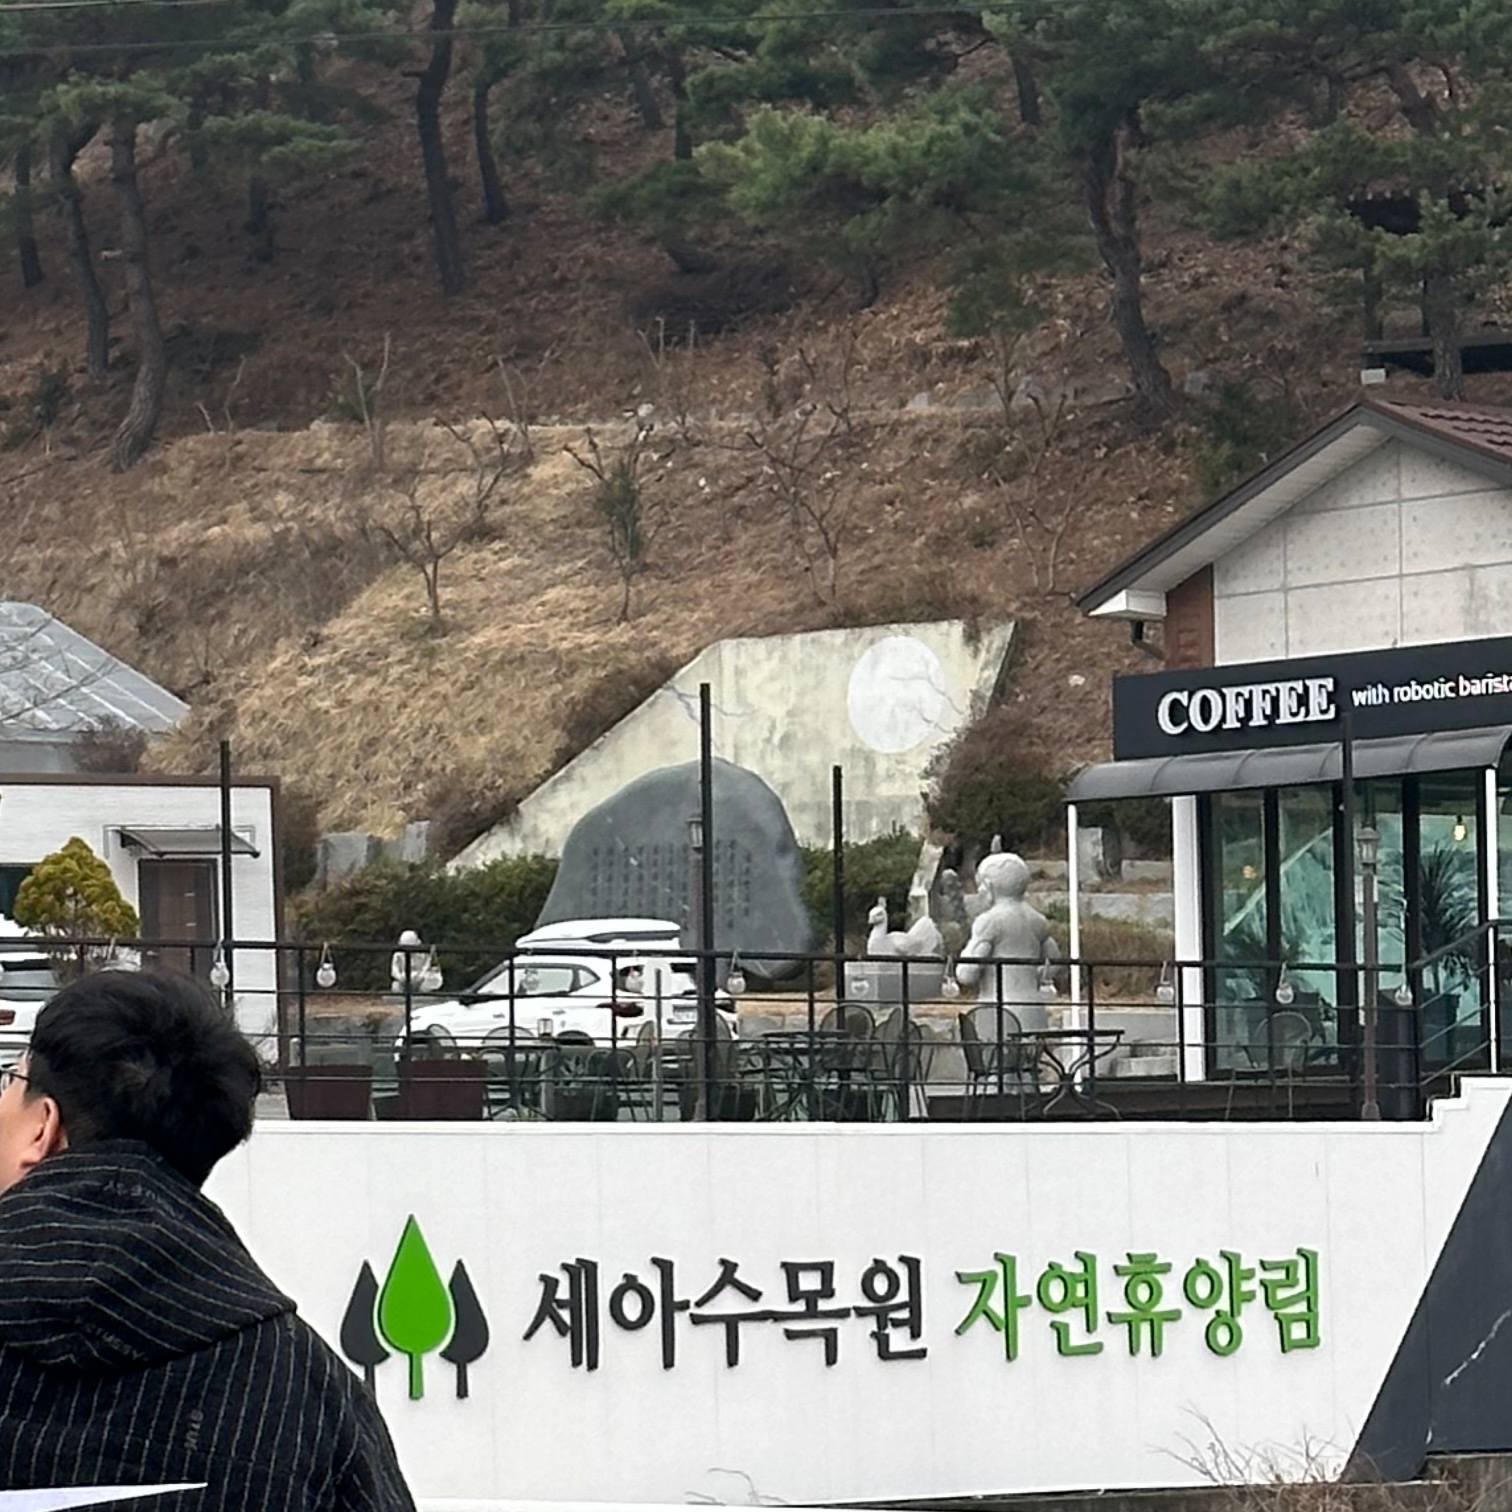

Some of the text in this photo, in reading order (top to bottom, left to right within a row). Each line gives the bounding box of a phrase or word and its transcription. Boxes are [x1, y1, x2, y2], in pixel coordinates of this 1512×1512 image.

[1157, 676, 1336, 736] COFFEE
[1351, 682, 1390, 708] with
[1393, 677, 1457, 704] robotic
[522, 1247, 1321, 1372] 세아수목원 자연휴양림
